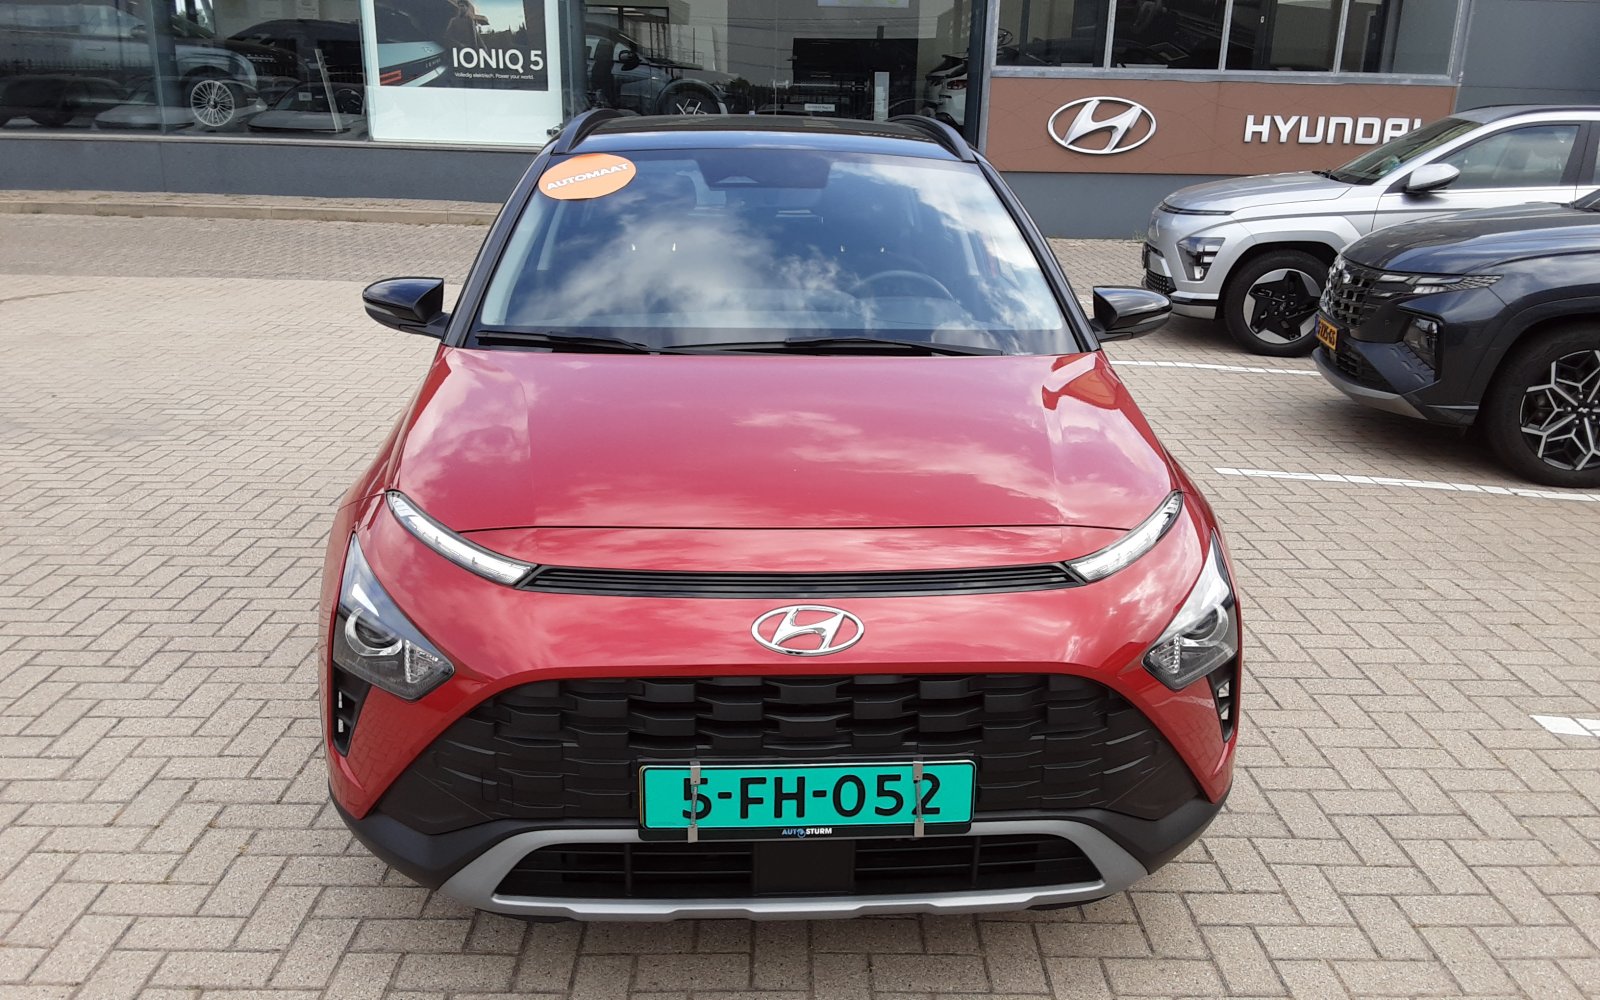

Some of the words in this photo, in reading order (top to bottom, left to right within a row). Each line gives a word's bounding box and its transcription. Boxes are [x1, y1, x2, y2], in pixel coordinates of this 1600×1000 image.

[452, 47, 524, 74] IONIQ
[529, 50, 544, 71] 5
[547, 163, 628, 190] AUTOMAAT
[682, 773, 941, 820] 5-FH-052
